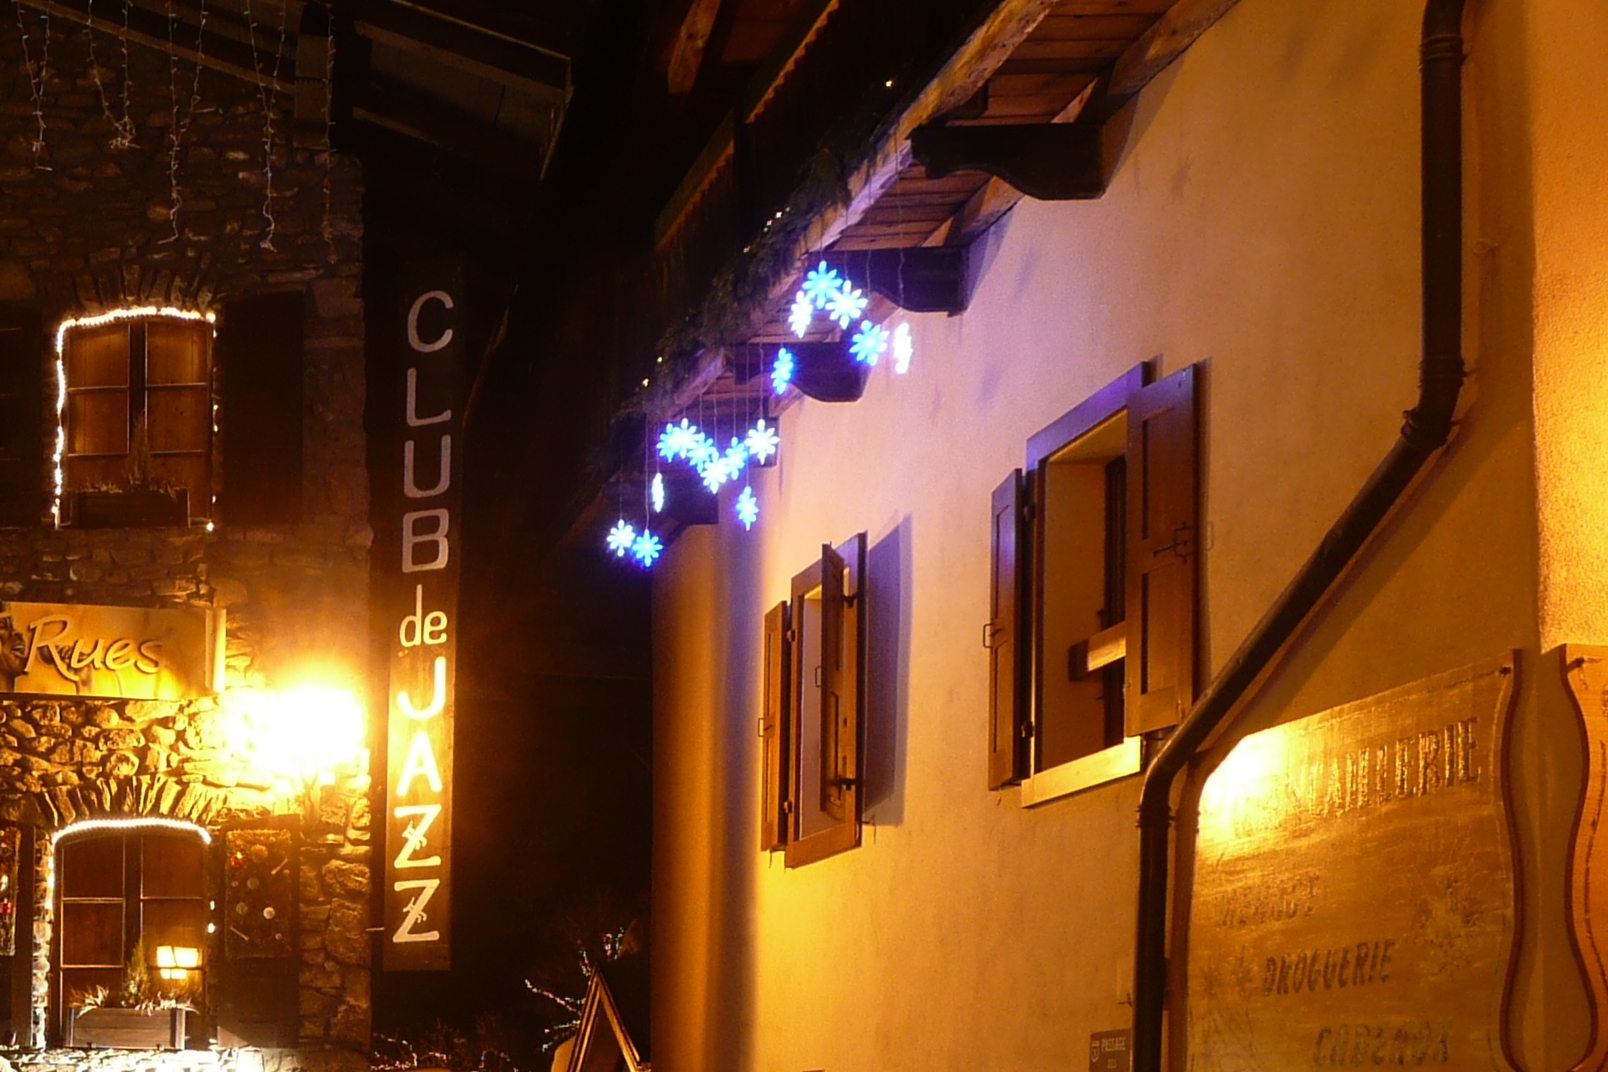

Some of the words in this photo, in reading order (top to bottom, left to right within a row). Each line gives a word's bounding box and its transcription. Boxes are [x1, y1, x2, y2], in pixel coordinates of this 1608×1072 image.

[402, 290, 454, 573] CLUB
[24, 614, 166, 681] Rues
[398, 584, 447, 648] de
[392, 656, 447, 943] JAZZ
[1262, 939, 1396, 996] DROGUERIE
[1101, 1037, 1126, 1052] PASSAGE
